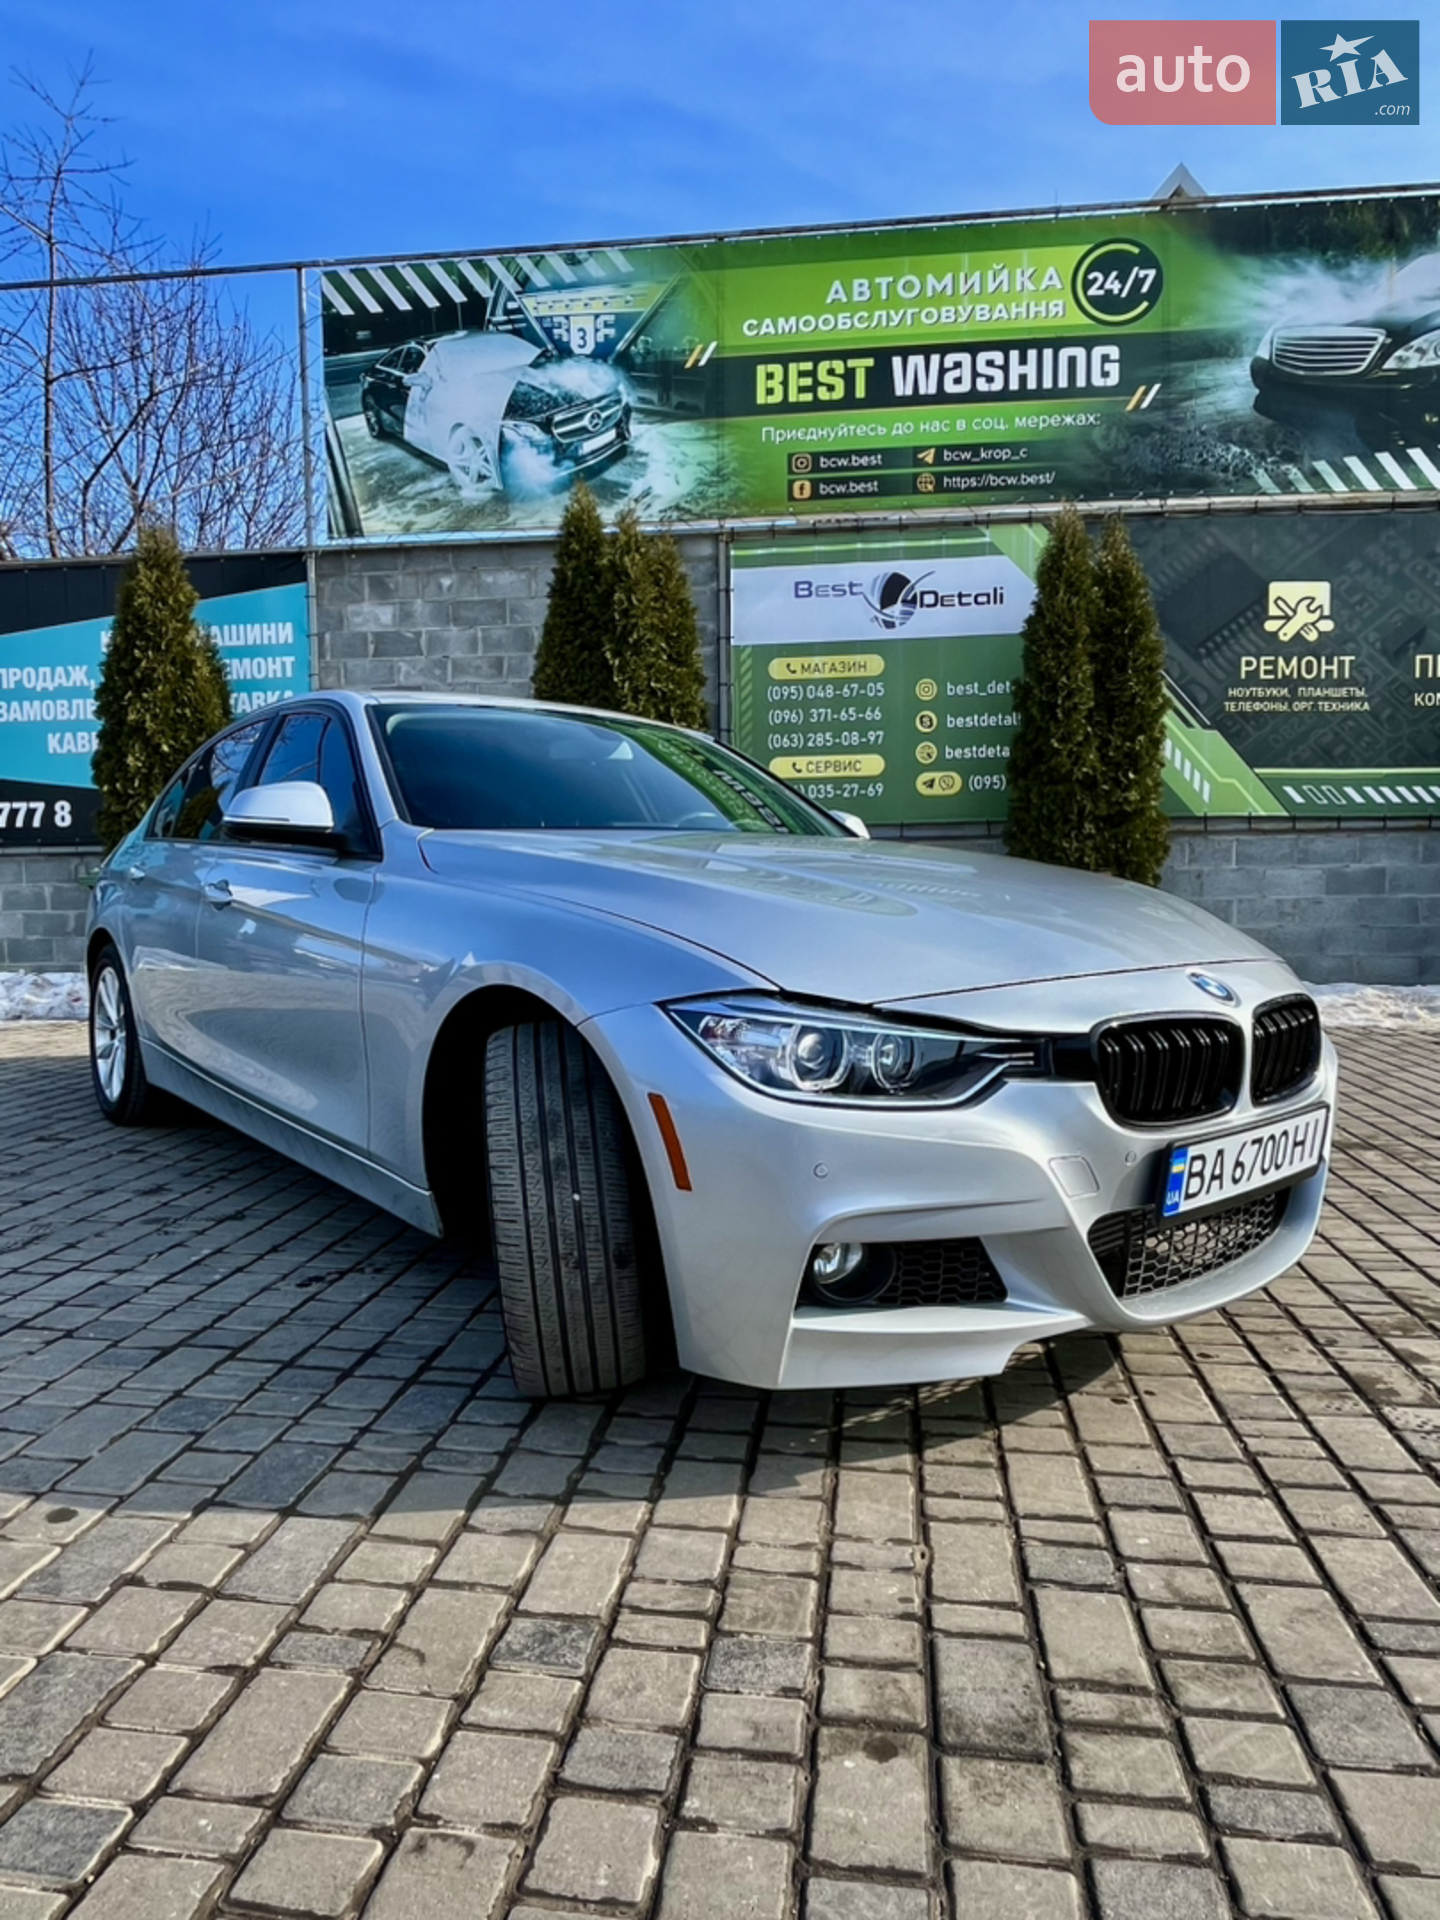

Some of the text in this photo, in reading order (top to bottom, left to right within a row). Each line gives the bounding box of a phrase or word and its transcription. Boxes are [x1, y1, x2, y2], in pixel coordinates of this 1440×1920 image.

[825, 264, 1064, 304] АВТОМИЙКА
[1085, 267, 1157, 299] 24/7
[742, 300, 1066, 337] САМООБСЛУГОВУВАННЯ
[755, 357, 874, 406] BEST
[761, 413, 1101, 445] Приєднуйтесь до нас в соц. мережах:
[819, 454, 882, 469] bcw.best
[943, 447, 1028, 462] bcw_krop_c
[819, 480, 879, 495] bcw.best
[943, 471, 1057, 491] https://bcw.best/
[210, 622, 294, 646] АШИНИ
[800, 660, 868, 675] МАГАЗИН
[1240, 655, 1356, 680] РЕМОНТ
[767, 682, 885, 703] (095) 048-67-05
[1228, 686, 1291, 698] НОУТБУКИ,
[768, 706, 882, 726] (096) 371-65-66
[767, 730, 885, 750] (063) 285-08-97
[805, 760, 862, 774] СЕРВИС
[968, 774, 1007, 792] (095)
[1165, 1189, 1180, 1206] UA
